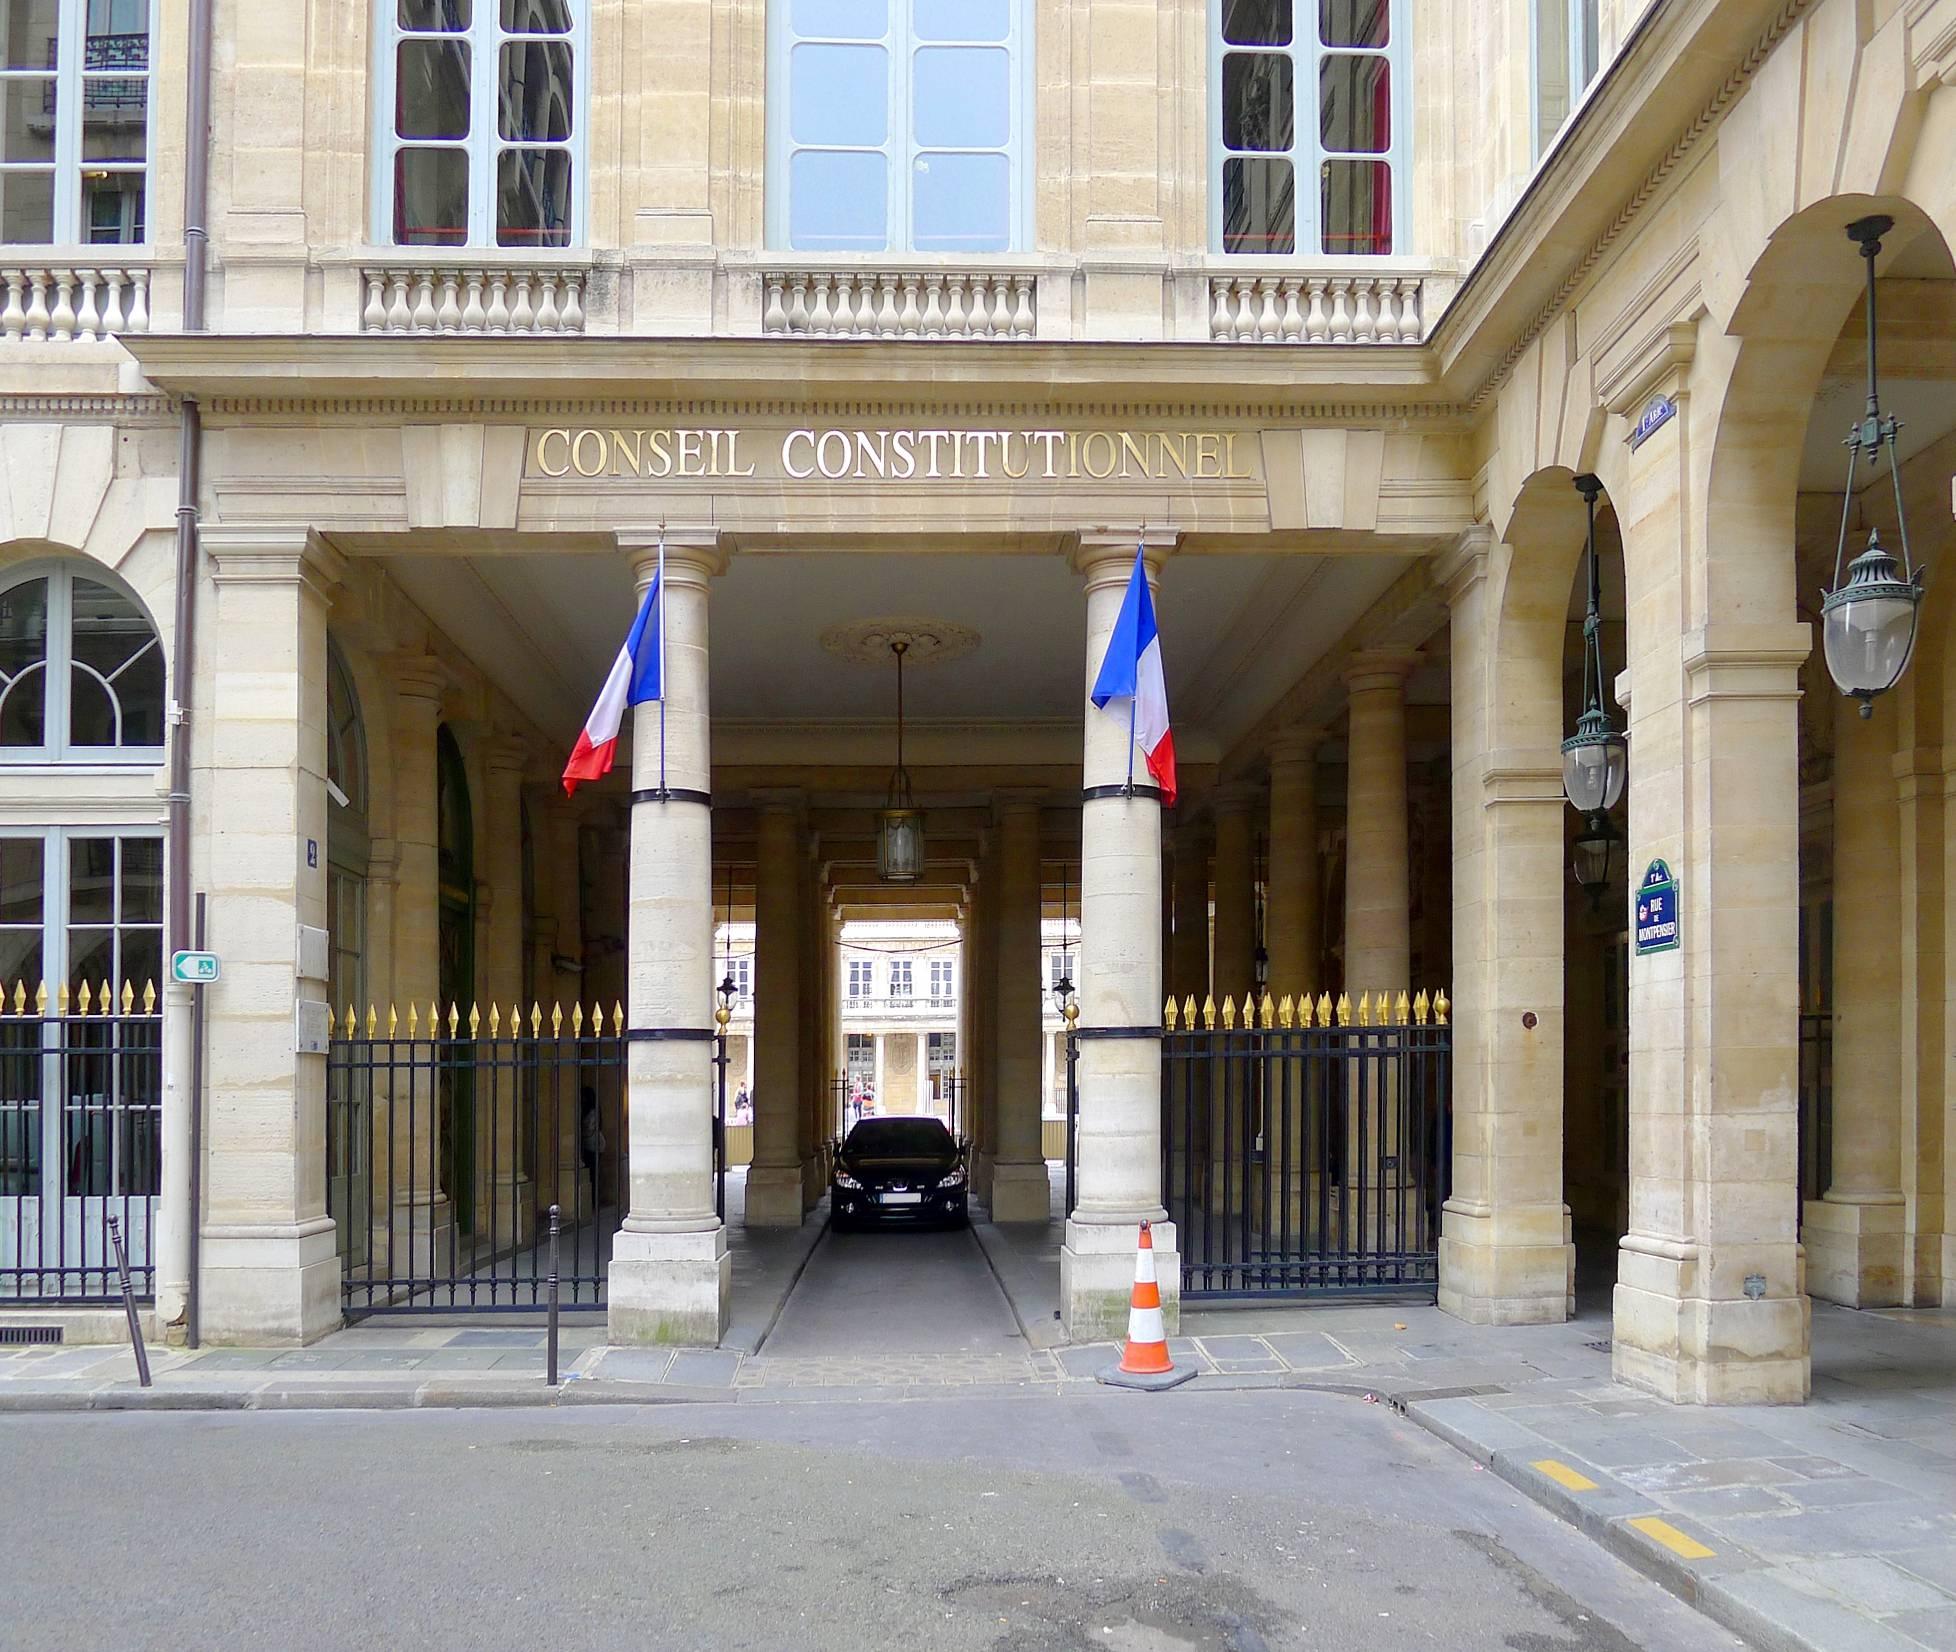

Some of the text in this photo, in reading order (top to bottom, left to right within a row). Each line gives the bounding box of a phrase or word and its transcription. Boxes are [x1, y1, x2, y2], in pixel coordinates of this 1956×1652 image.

[537, 428, 1255, 478] CONSEIL CONSTITUTIONNEL
[1650, 897, 1663, 913] RUE
[1653, 914, 1660, 922] DE
[1638, 921, 1676, 942] MONTPENSIER
